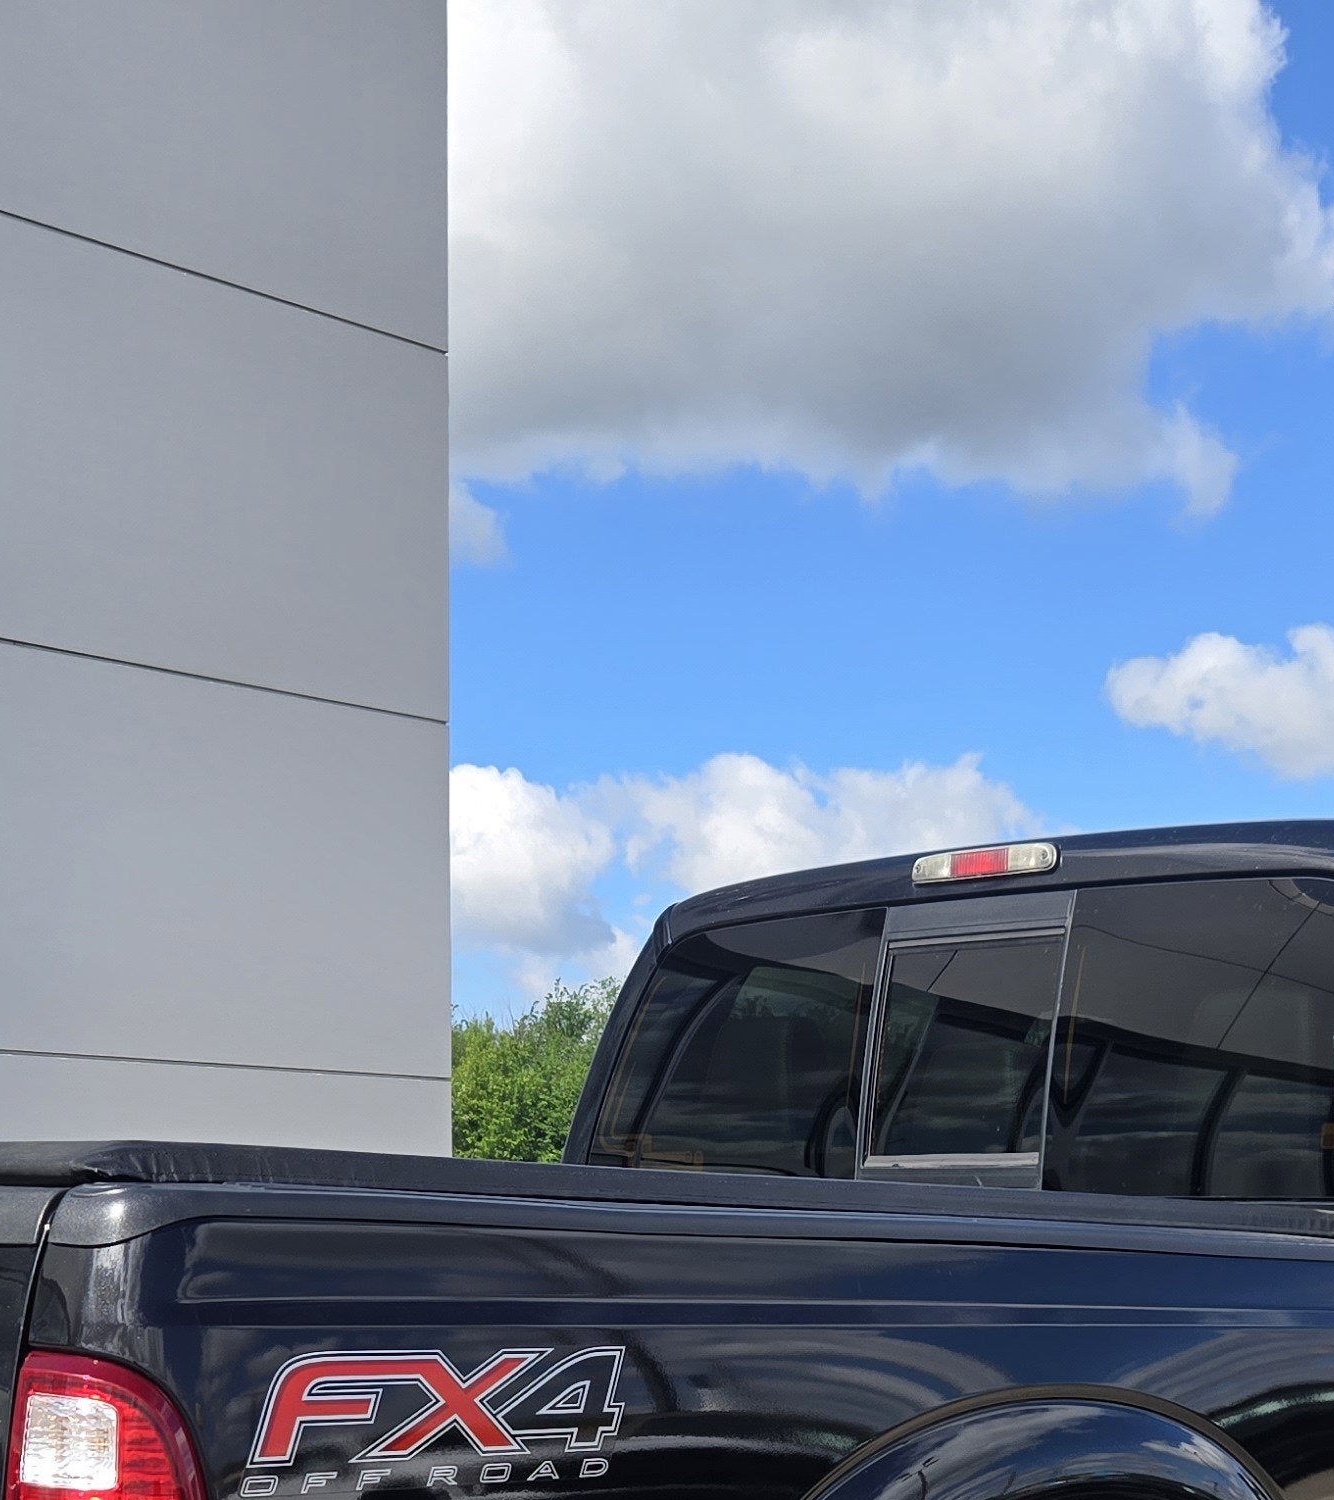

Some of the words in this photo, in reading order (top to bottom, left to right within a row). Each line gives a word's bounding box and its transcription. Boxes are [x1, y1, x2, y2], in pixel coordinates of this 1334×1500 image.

[247, 1346, 625, 1468] FX4
[240, 1469, 391, 1498] OFF
[427, 1458, 609, 1487] ROAD
